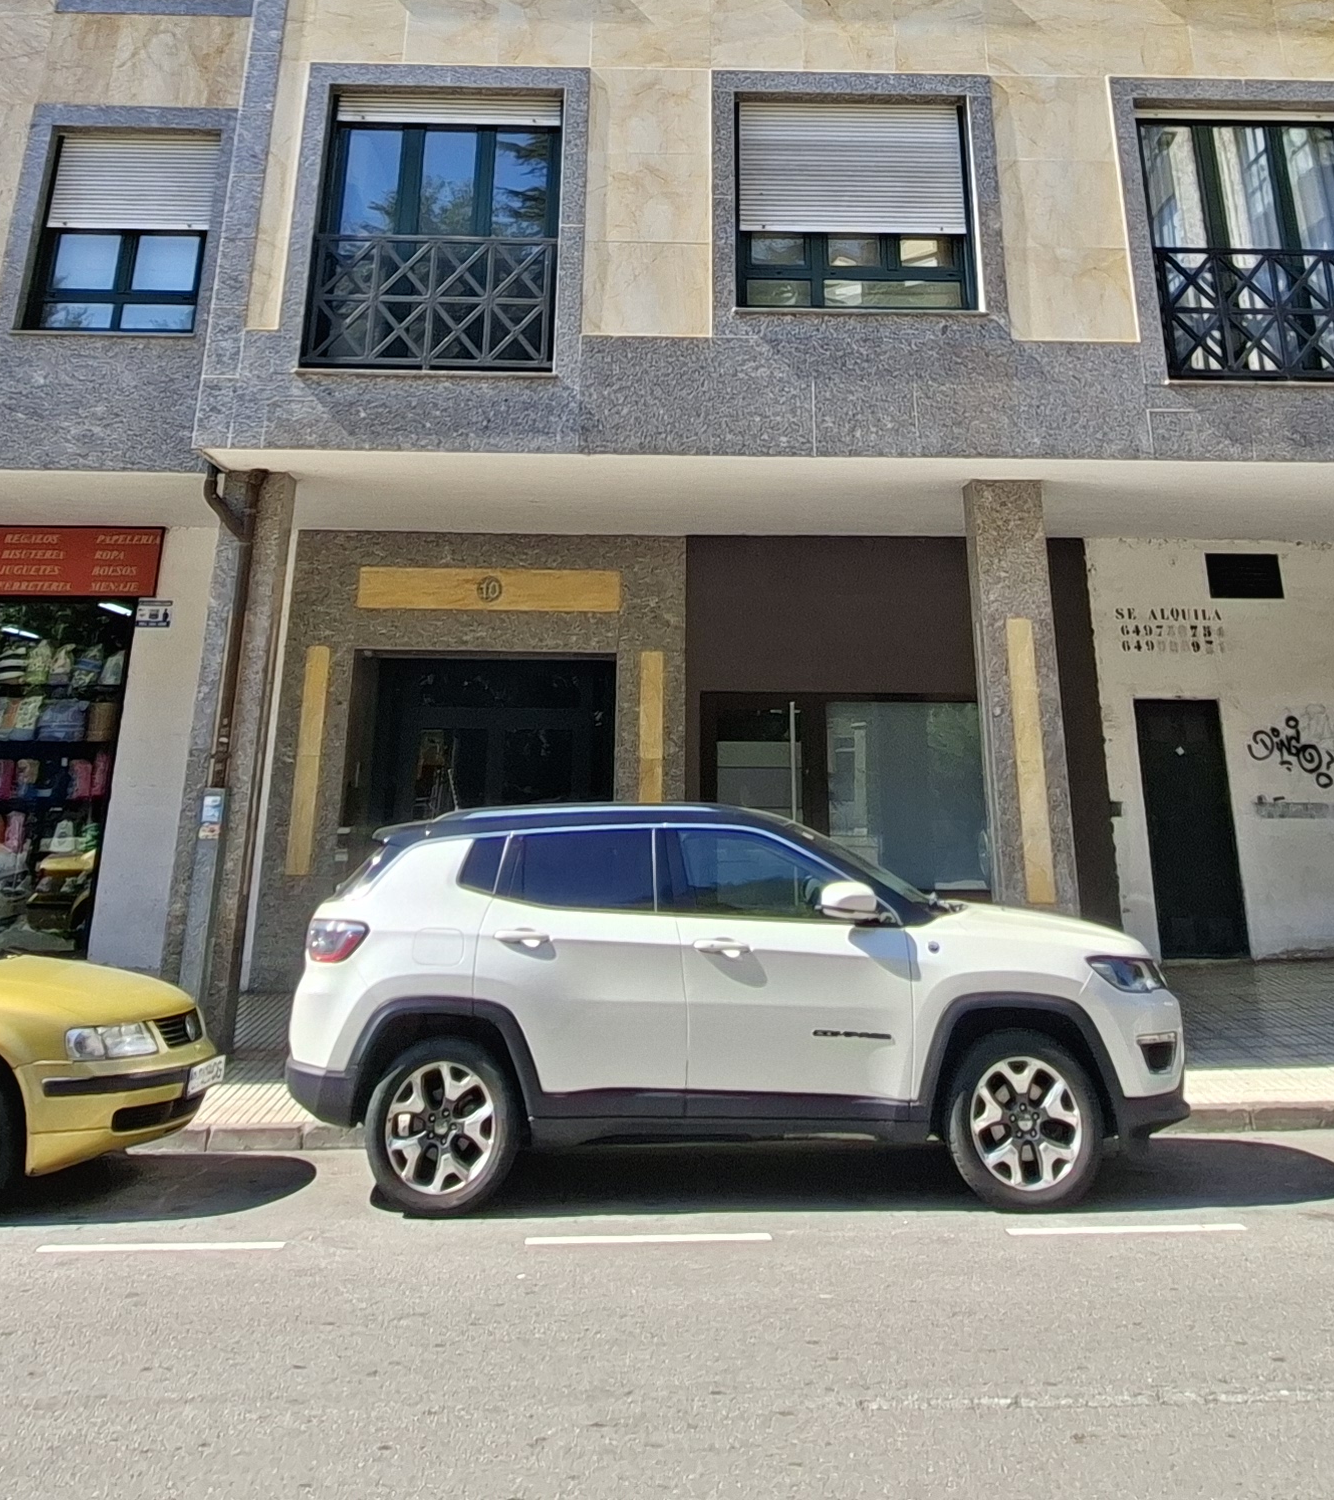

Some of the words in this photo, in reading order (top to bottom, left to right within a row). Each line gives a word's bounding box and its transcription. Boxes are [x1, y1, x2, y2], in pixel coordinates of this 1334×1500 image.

[3, 533, 62, 544] REGALOS
[93, 550, 125, 560] ROPA
[91, 566, 138, 576] BOLSOS
[1115, 607, 1137, 620] SE
[1148, 606, 1222, 622] ALQUILA
